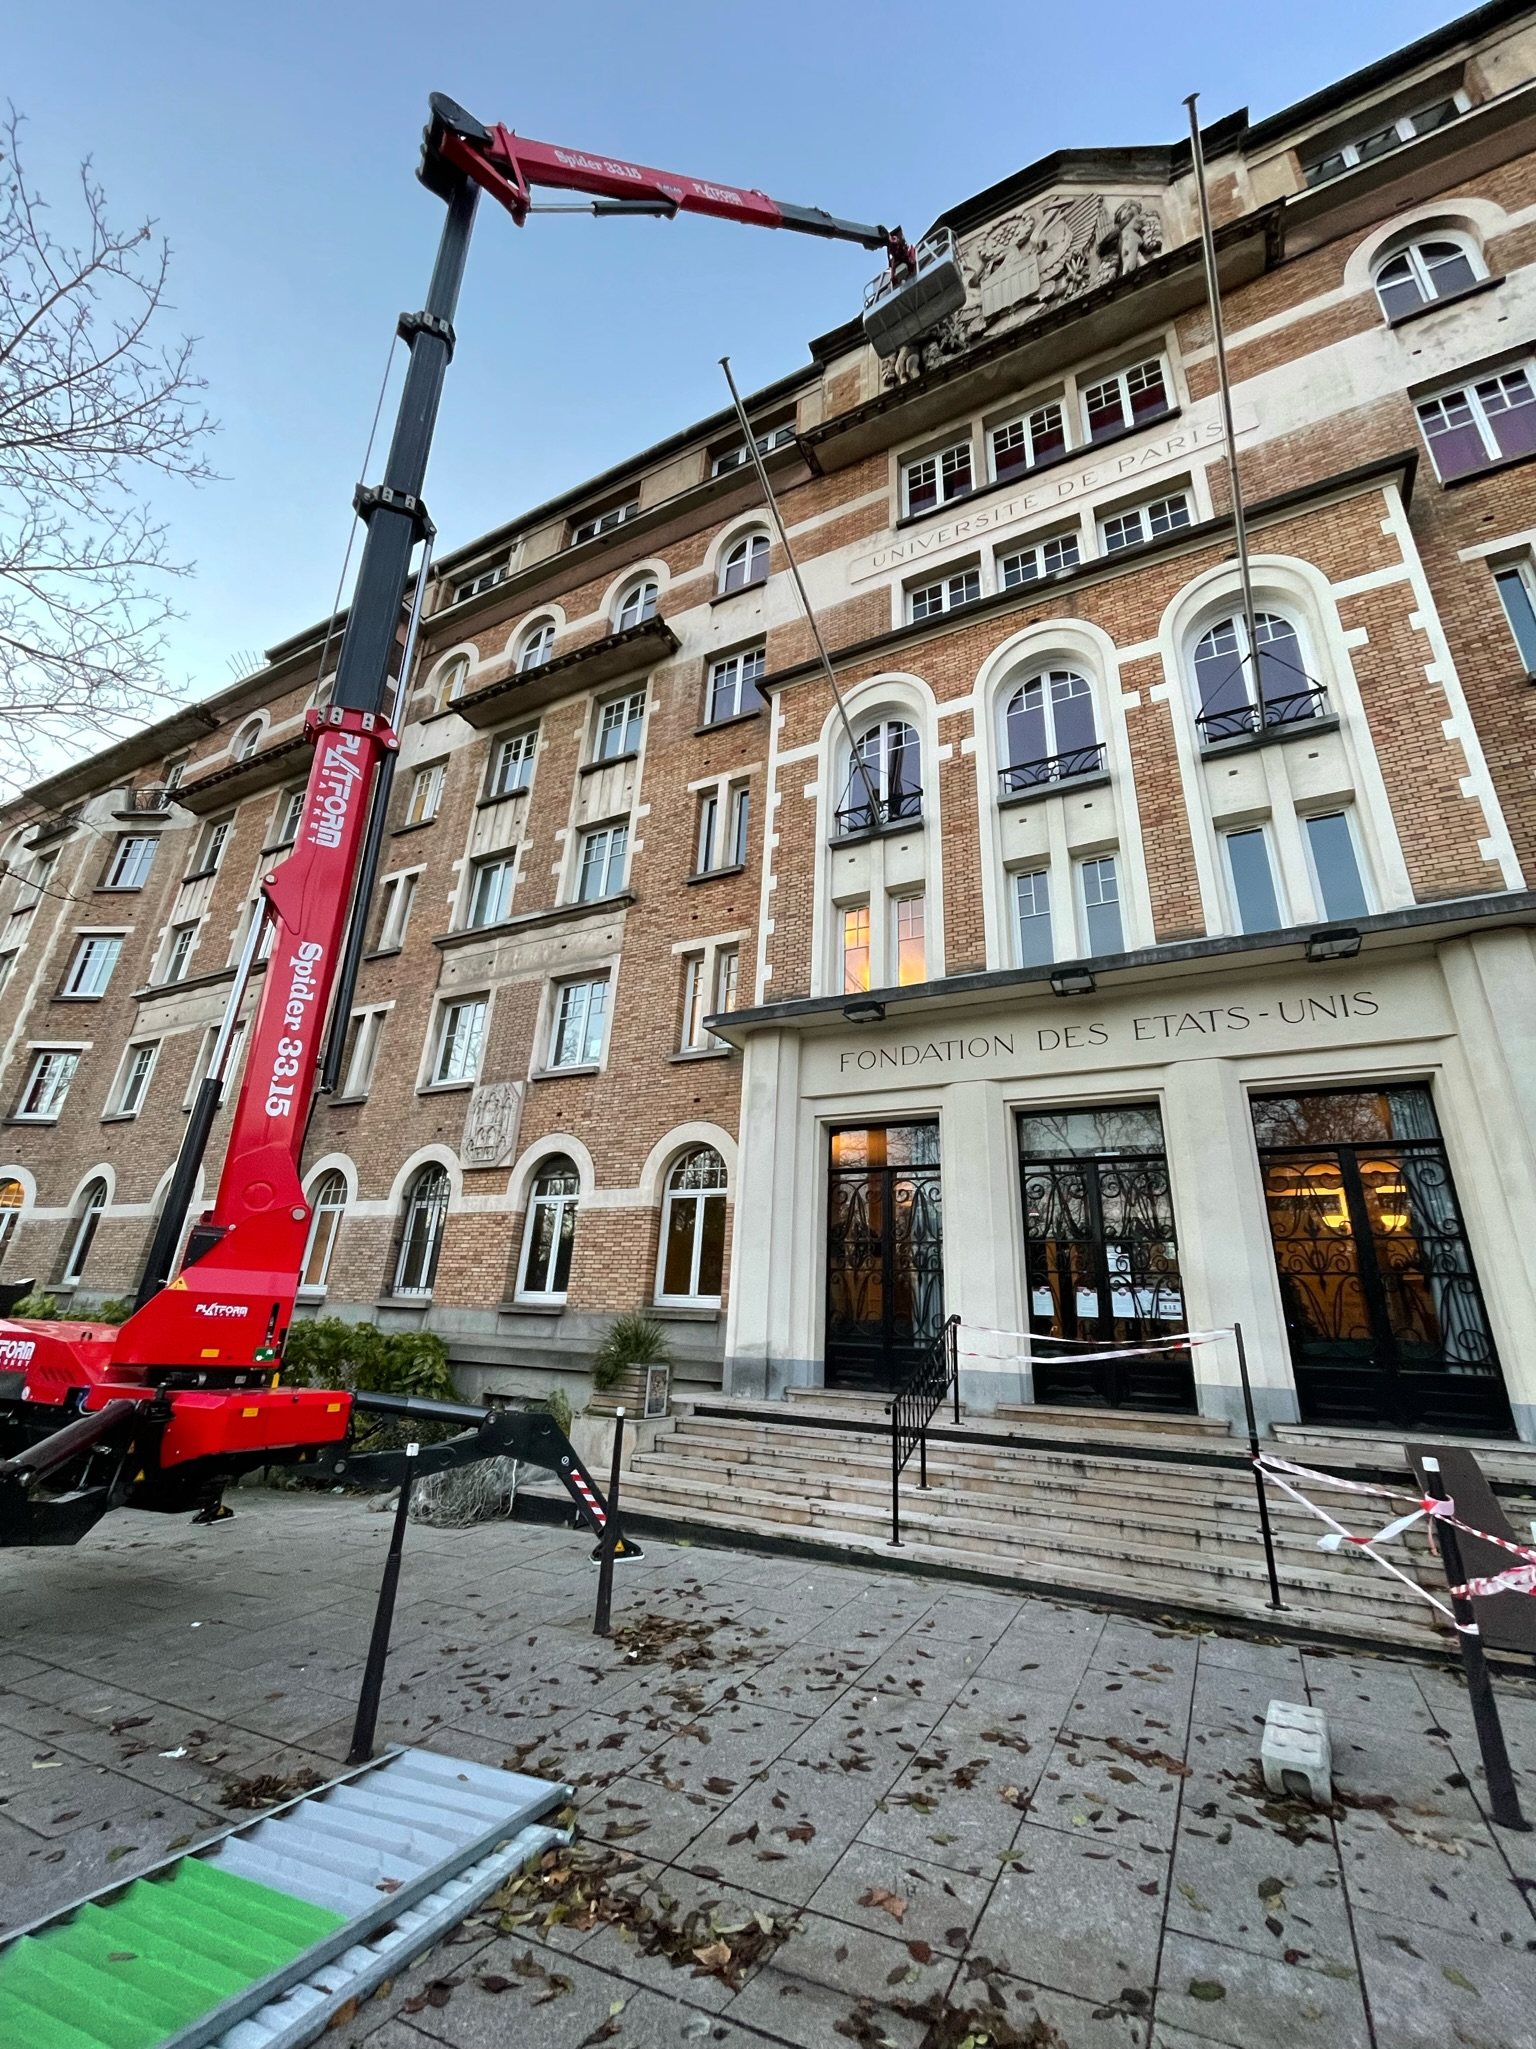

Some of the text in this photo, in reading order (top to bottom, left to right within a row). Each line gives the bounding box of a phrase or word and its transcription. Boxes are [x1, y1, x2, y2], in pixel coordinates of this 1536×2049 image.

[554, 149, 602, 171] Spider
[1057, 471, 1098, 497] DE
[1118, 422, 1223, 473] PARIS
[307, 768, 330, 843] BASKET
[315, 732, 362, 848] PLATFORM
[265, 941, 323, 1117] Spider 33.15
[840, 991, 1379, 1073] FONDATION DES ETATS-UNIS
[195, 1302, 248, 1316] PLATFORM
[0, 1339, 36, 1360] FORM
